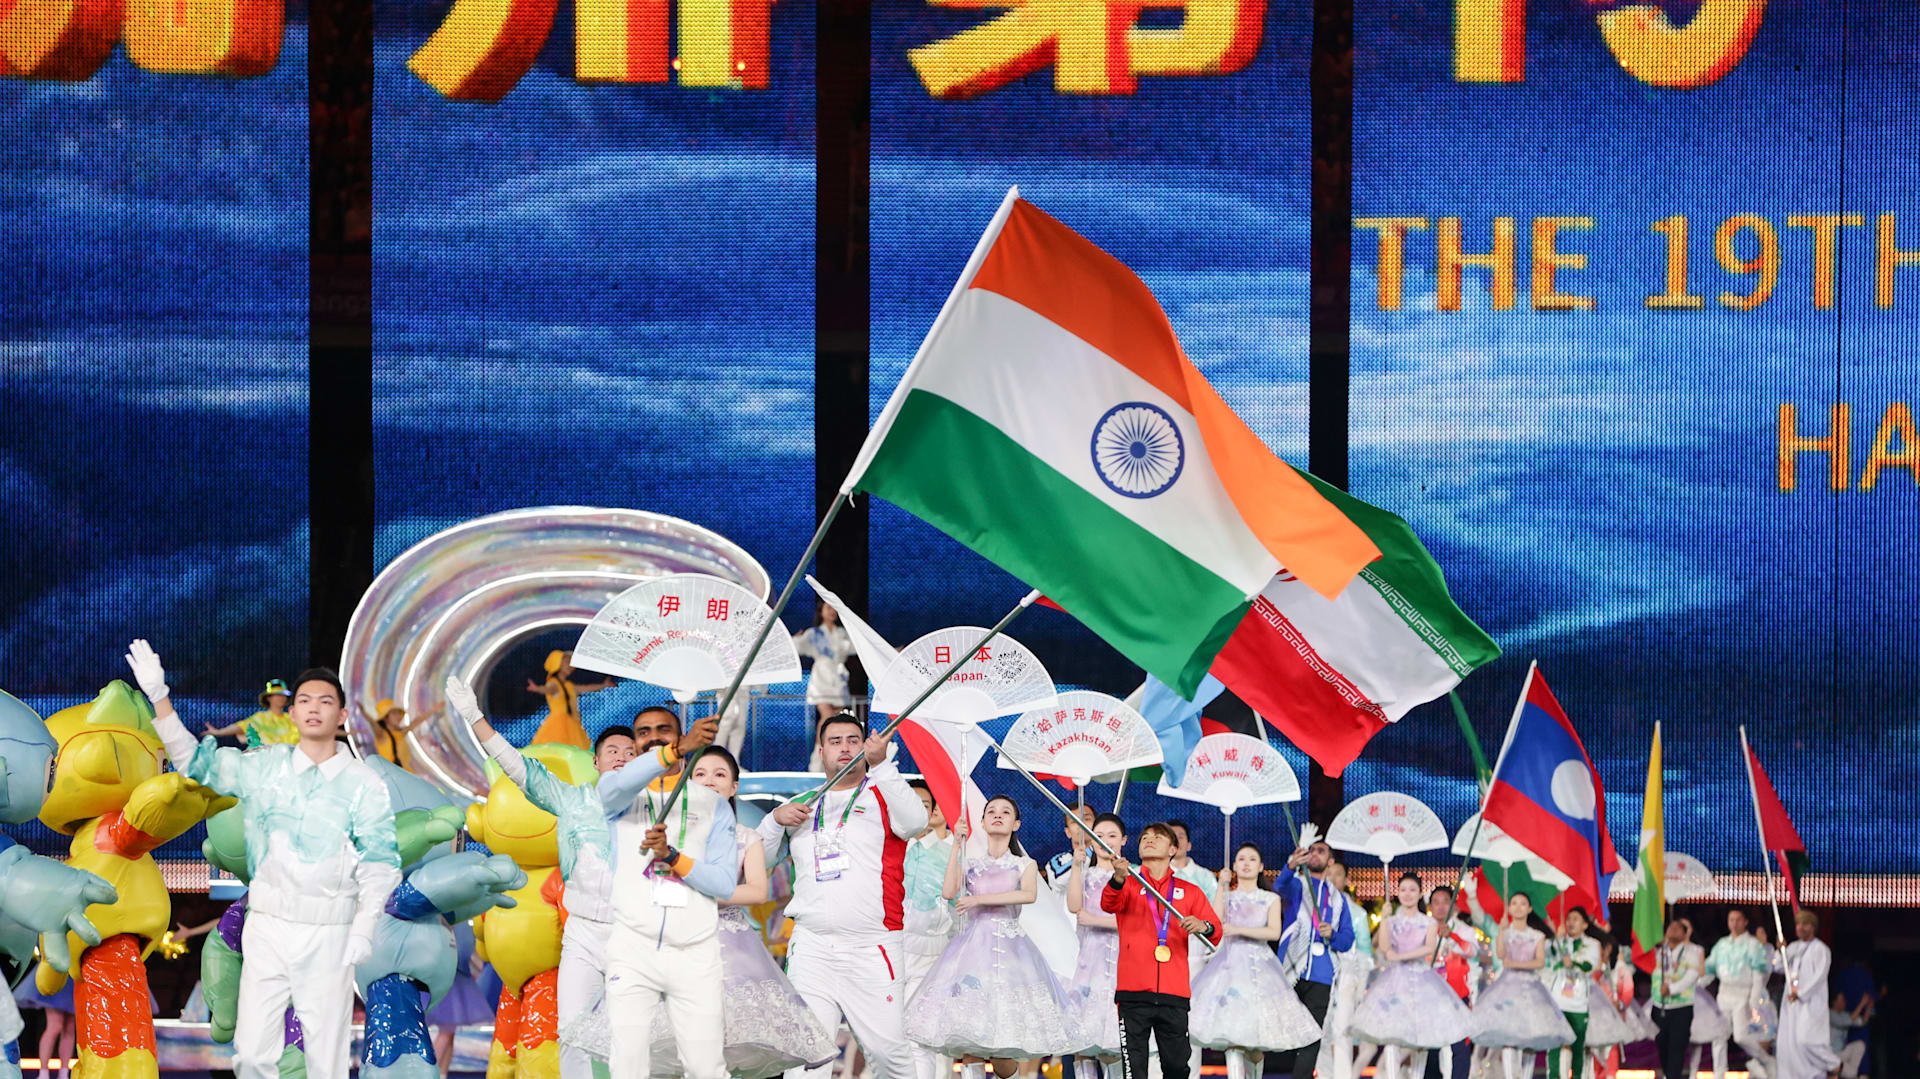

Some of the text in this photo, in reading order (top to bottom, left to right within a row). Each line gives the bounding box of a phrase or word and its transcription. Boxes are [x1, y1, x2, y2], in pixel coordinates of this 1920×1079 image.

[1353, 216, 1597, 311] THE
[657, 595, 729, 621] 伊朗
[633, 637, 664, 664] Islamic
[935, 647, 992, 663] 日本
[1037, 708, 1122, 733] 哈萨克斯坦
[1048, 733, 1112, 755] Kazakhstan
[1197, 748, 1264, 771] 科威特
[1212, 770, 1249, 781] Kuwait
[1119, 1017, 1132, 1079] TEAM JAPAN
